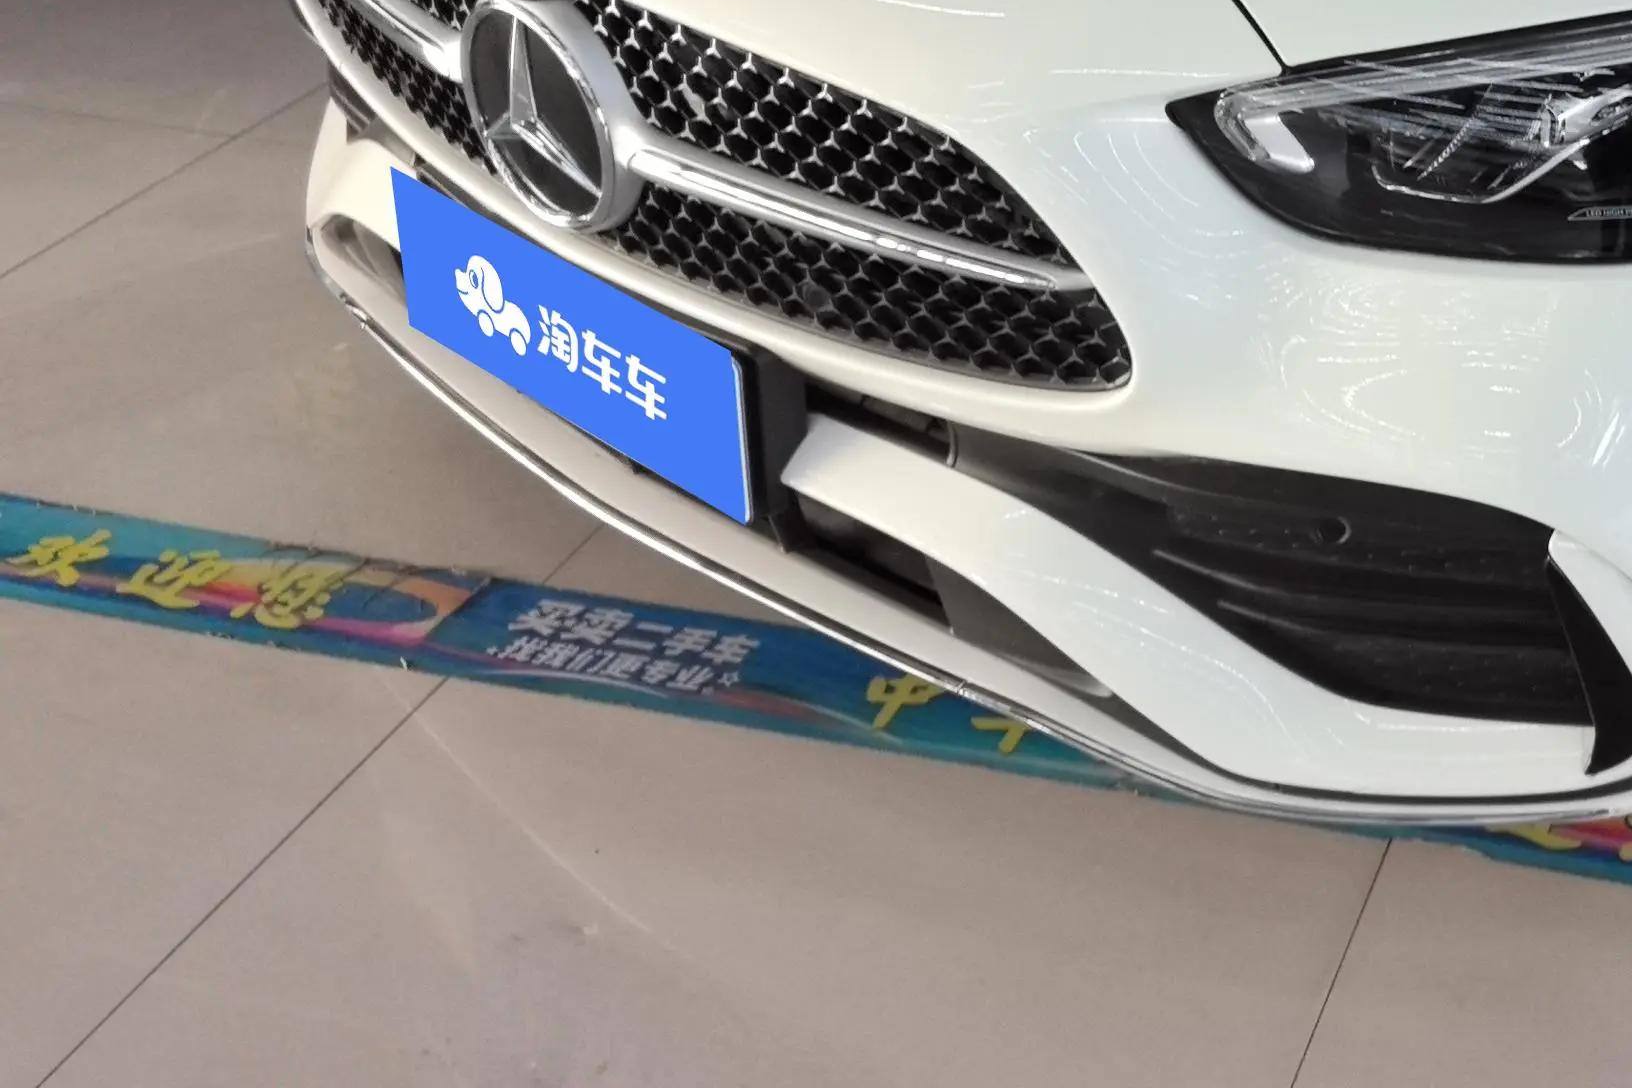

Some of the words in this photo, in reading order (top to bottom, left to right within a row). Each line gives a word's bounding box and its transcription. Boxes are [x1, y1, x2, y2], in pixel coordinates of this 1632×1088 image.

[508, 599, 760, 663] 买卖二手车
[498, 635, 713, 691] 找我们更专业
